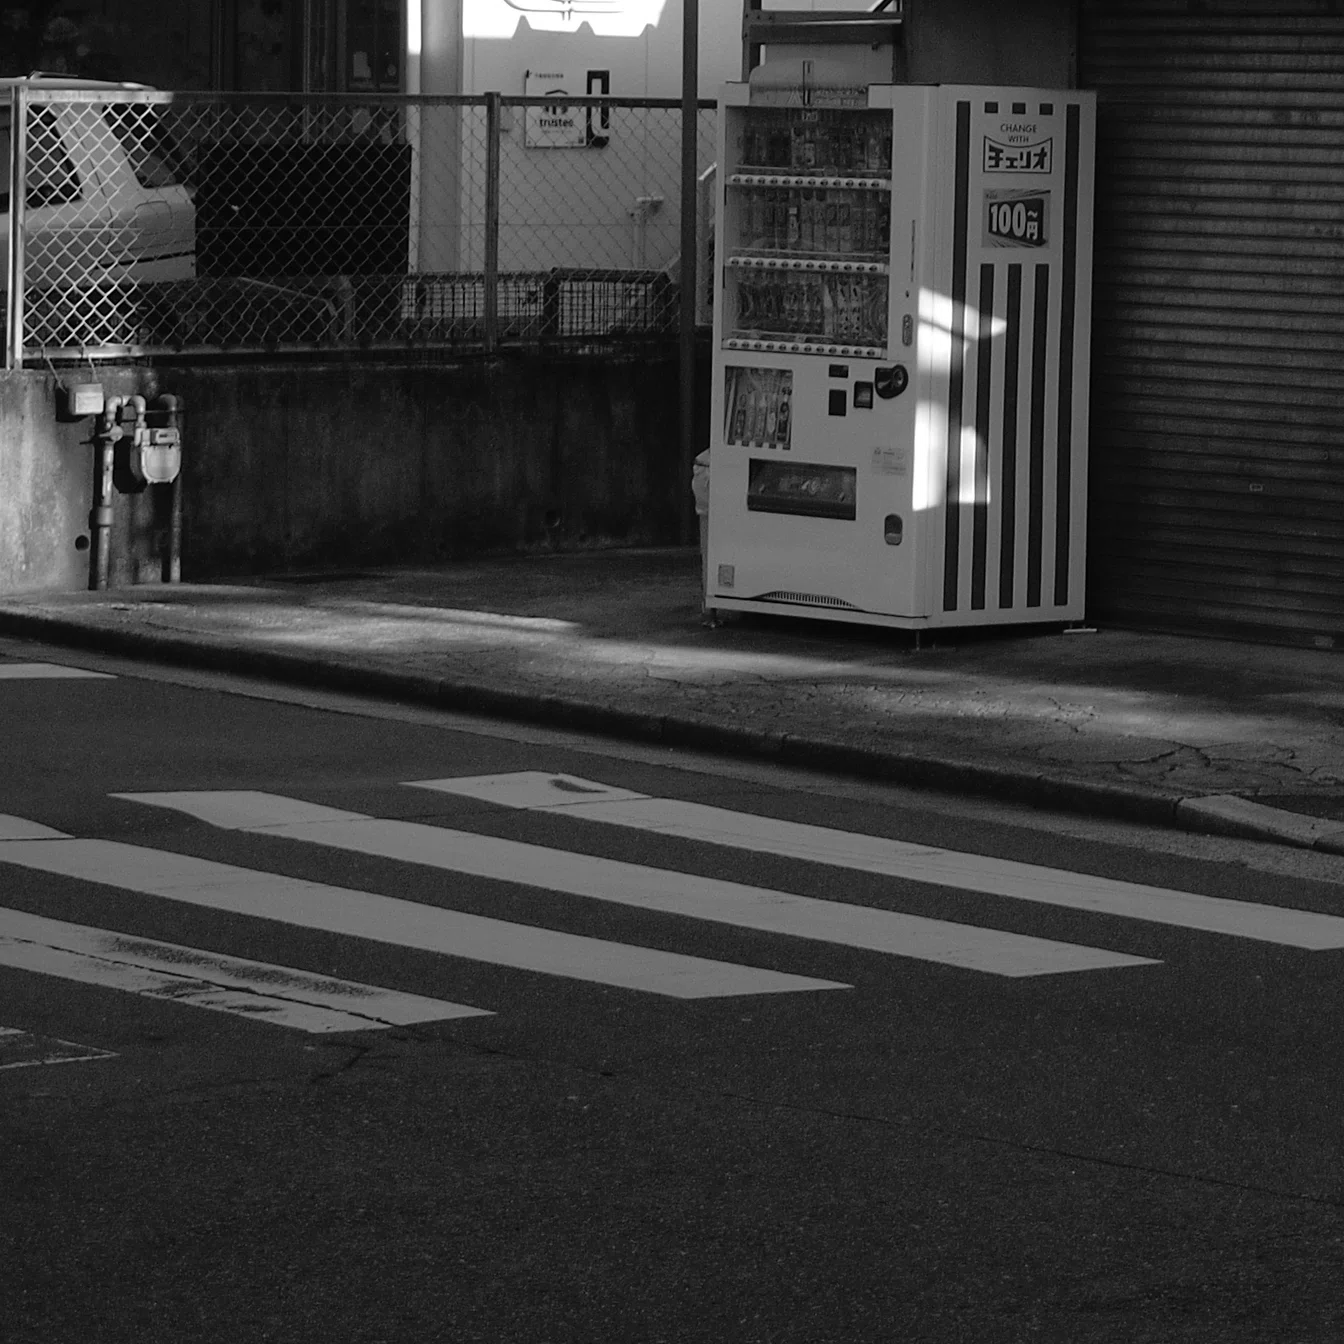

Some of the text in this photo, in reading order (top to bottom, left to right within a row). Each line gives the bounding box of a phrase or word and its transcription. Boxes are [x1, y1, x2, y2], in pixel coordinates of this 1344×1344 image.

[1000, 123, 1038, 133] CHANGE
[1008, 135, 1029, 143] WITH
[988, 144, 1047, 170] チェリオ
